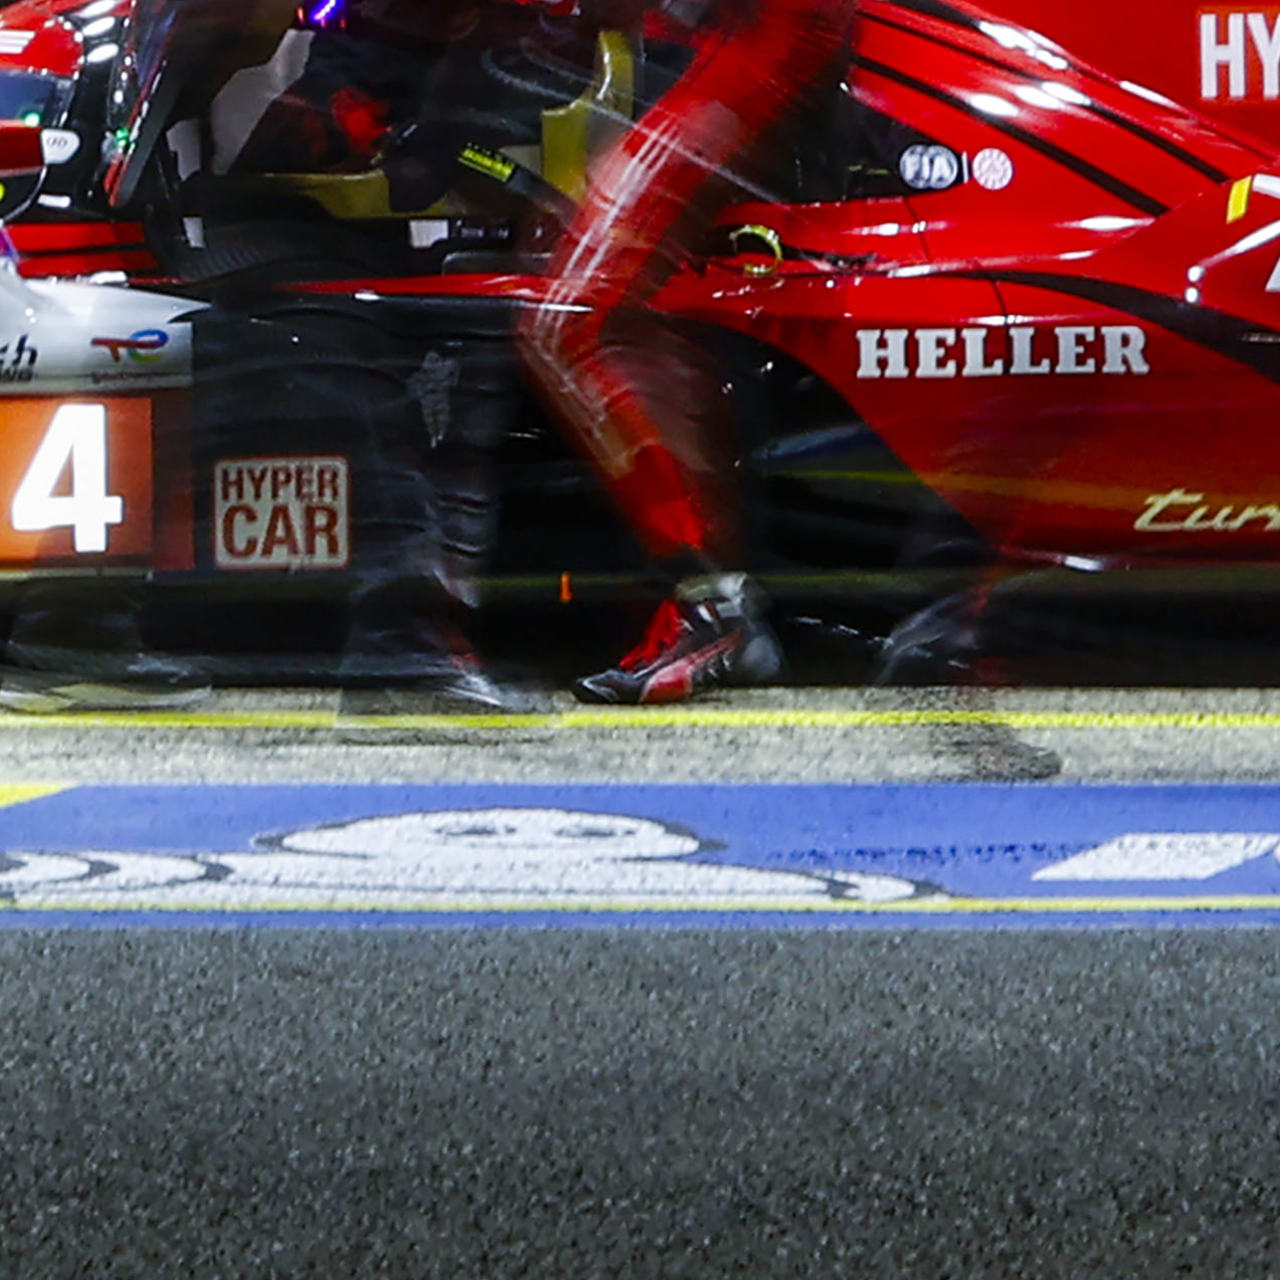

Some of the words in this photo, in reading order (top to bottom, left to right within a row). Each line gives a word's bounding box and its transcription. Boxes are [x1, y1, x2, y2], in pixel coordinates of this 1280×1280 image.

[855, 324, 1151, 379] HELLER
[10, 403, 124, 553] 4
[221, 464, 340, 502] HYPER
[220, 504, 340, 559] CAR
